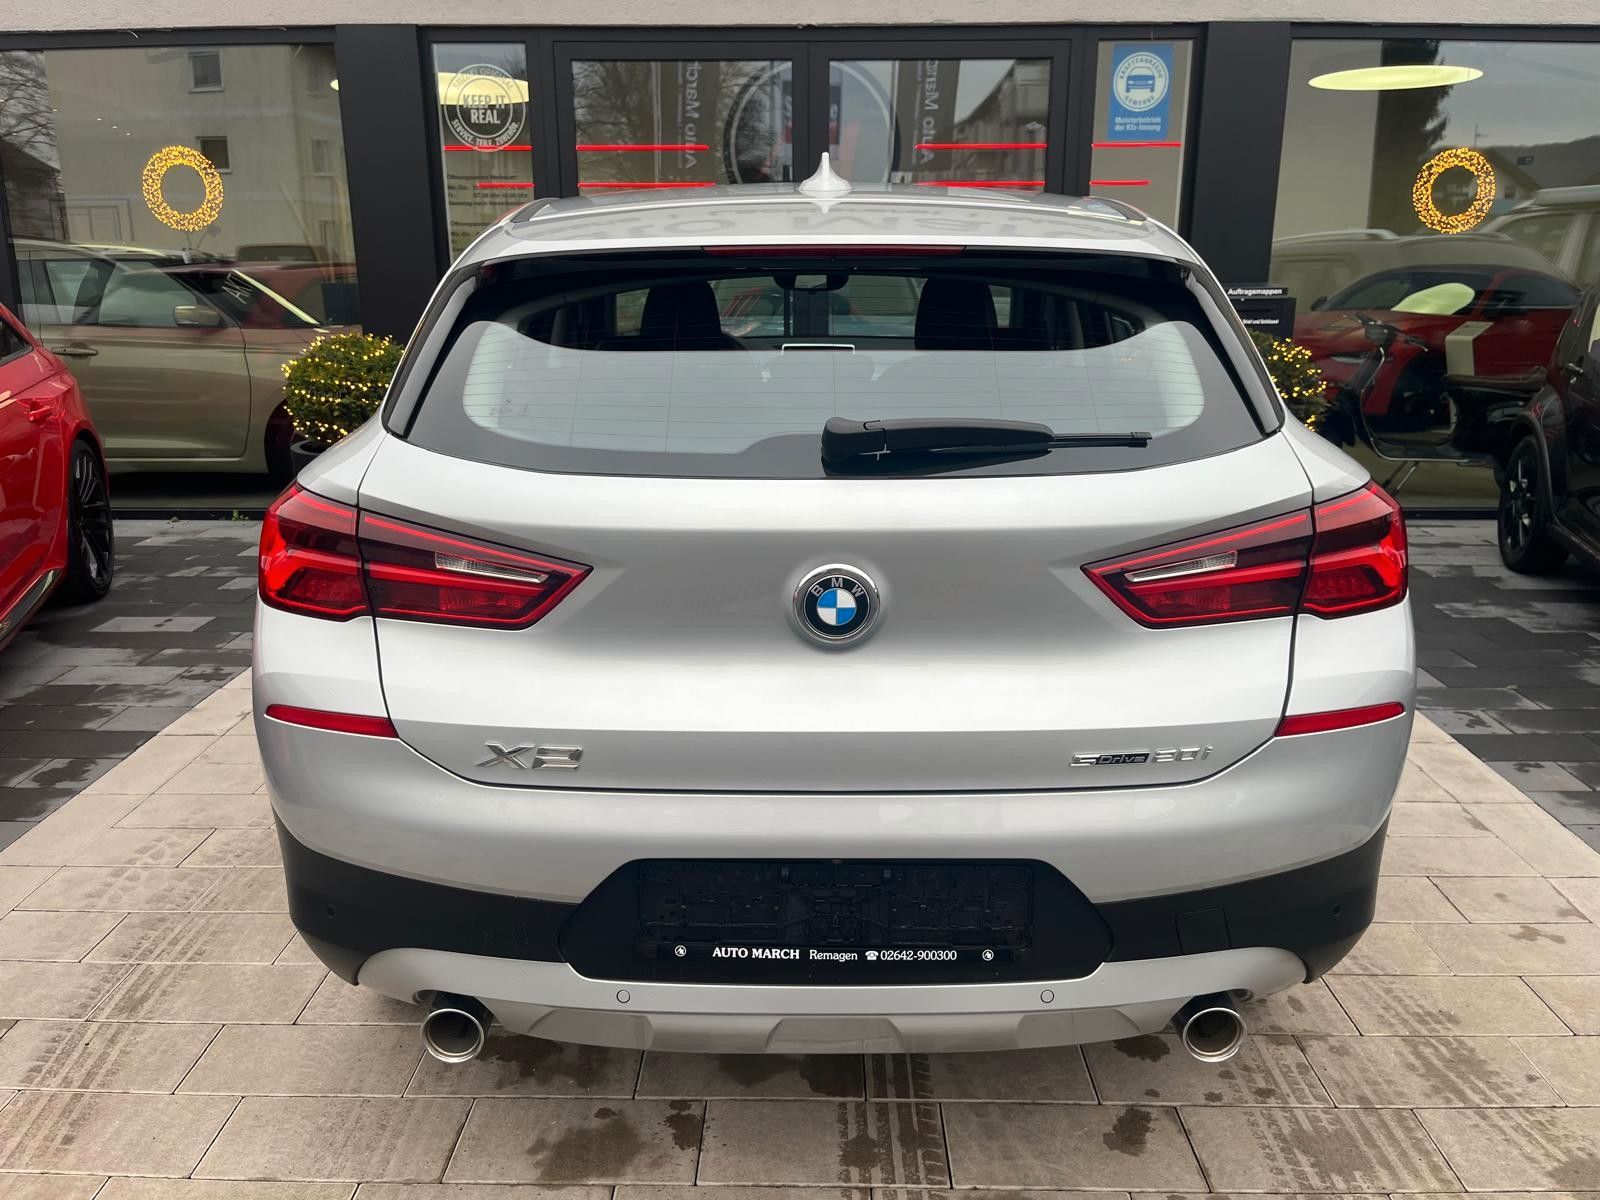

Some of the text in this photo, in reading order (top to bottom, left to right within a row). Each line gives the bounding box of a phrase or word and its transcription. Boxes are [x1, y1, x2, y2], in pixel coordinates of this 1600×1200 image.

[463, 93, 507, 109] KEEP IT
[470, 109, 501, 124] REAL
[1227, 288, 1282, 296] Auftragsmappen
[810, 577, 865, 598] BMW
[475, 742, 584, 770] X2
[712, 946, 958, 963] AUTO MARCH Remagen 02642-900300
